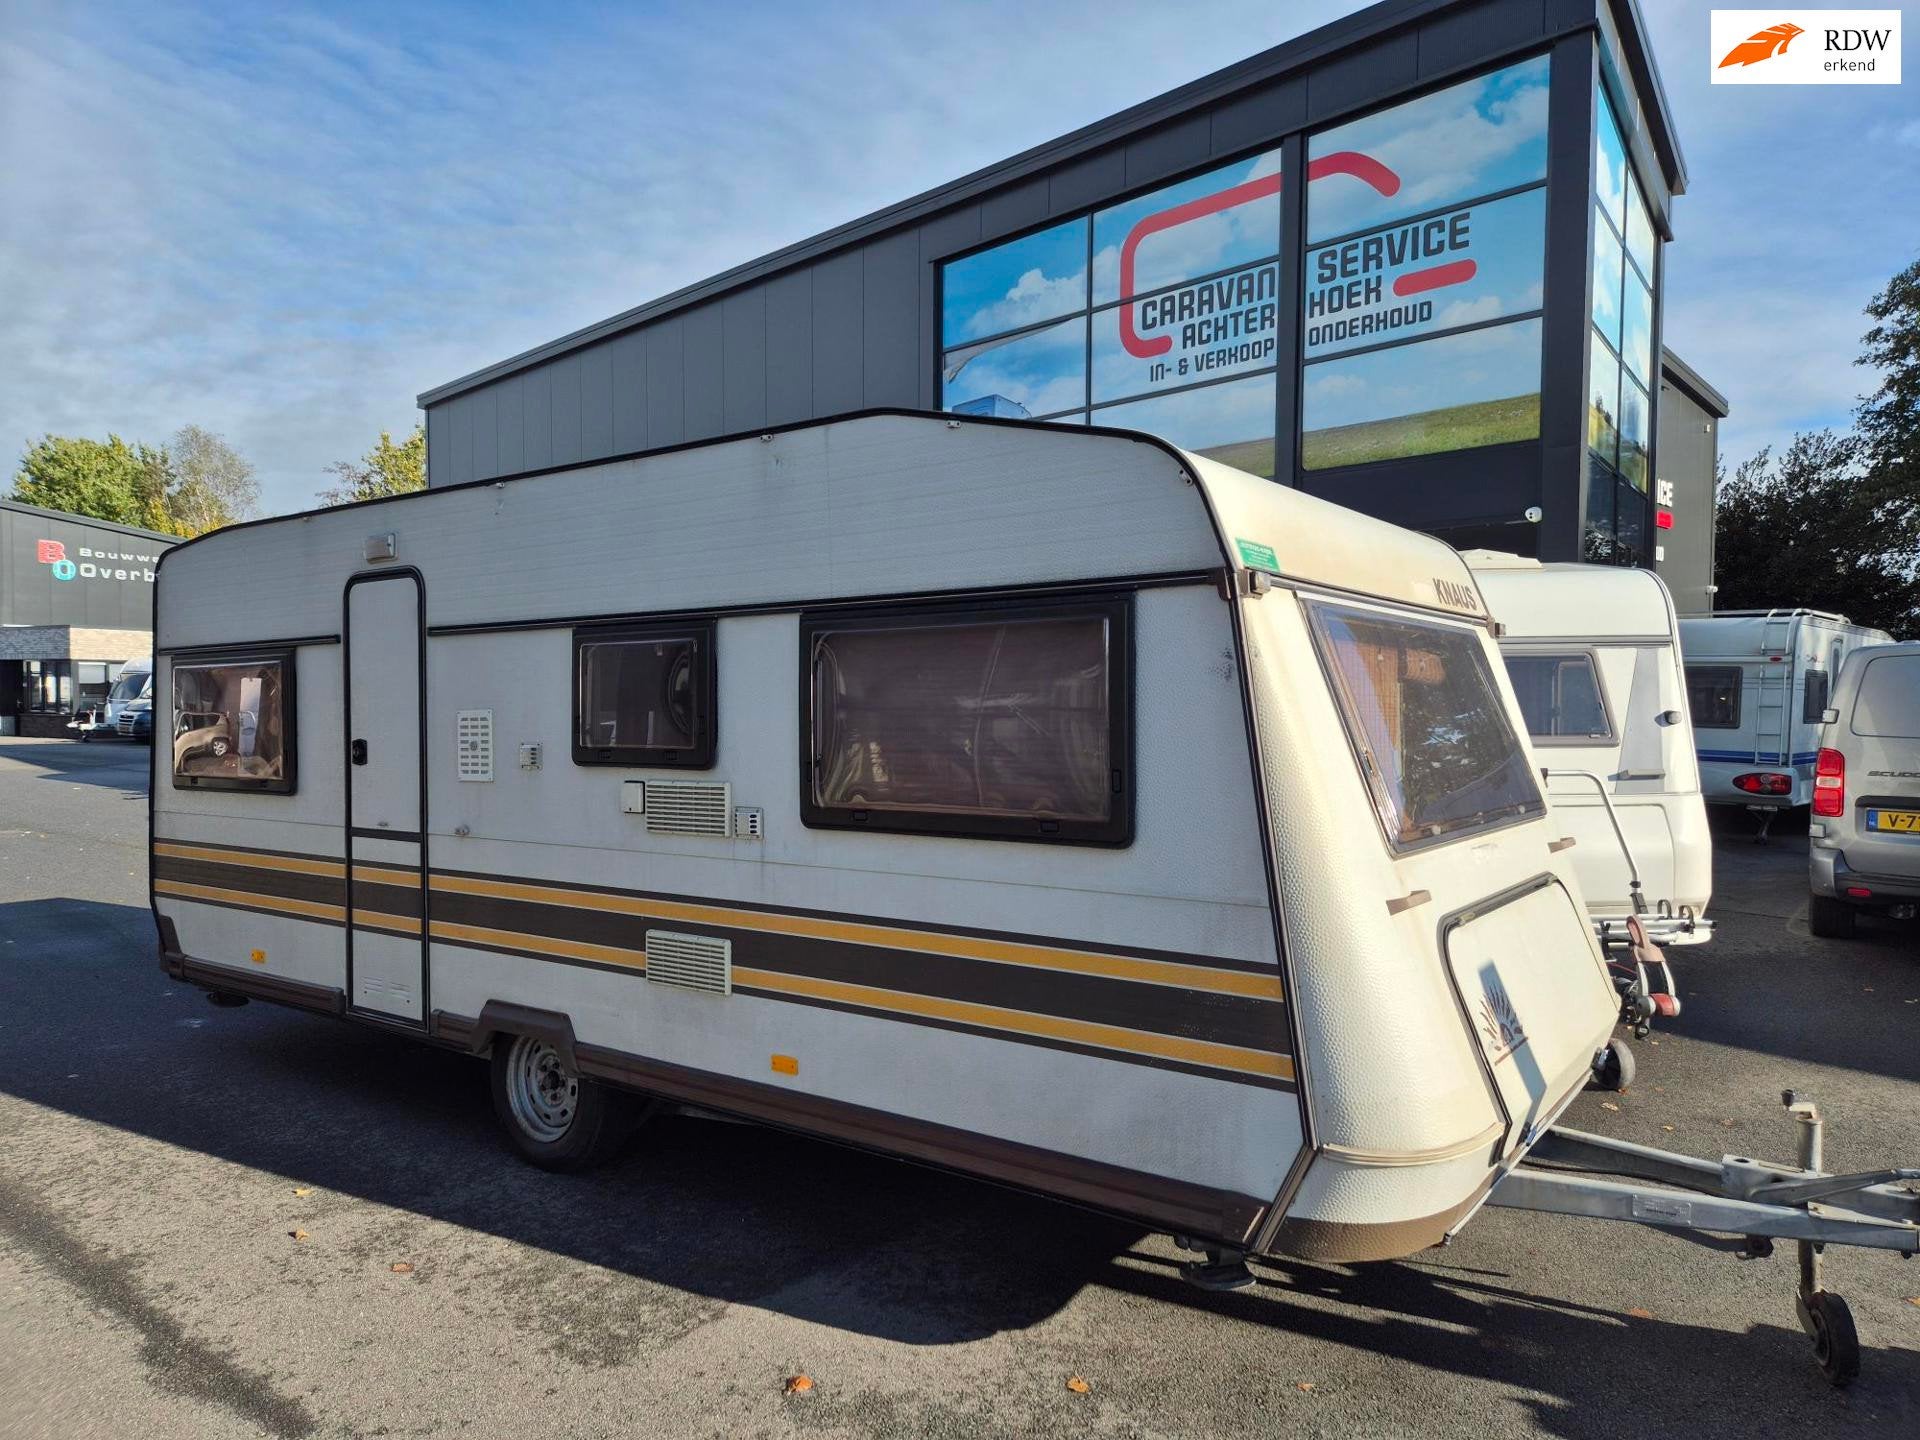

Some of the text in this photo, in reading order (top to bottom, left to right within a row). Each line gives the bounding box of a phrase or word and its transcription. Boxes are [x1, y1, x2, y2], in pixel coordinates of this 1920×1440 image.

[1142, 212, 1470, 331] CARAVAN SERVICE
[1150, 300, 1432, 382] IN- & VERKOOP ONDERHOUD
[1182, 275, 1382, 349] ACHTER HOEK
[1432, 577, 1477, 611] KNAUS
[1888, 813, 1920, 829] V-7
